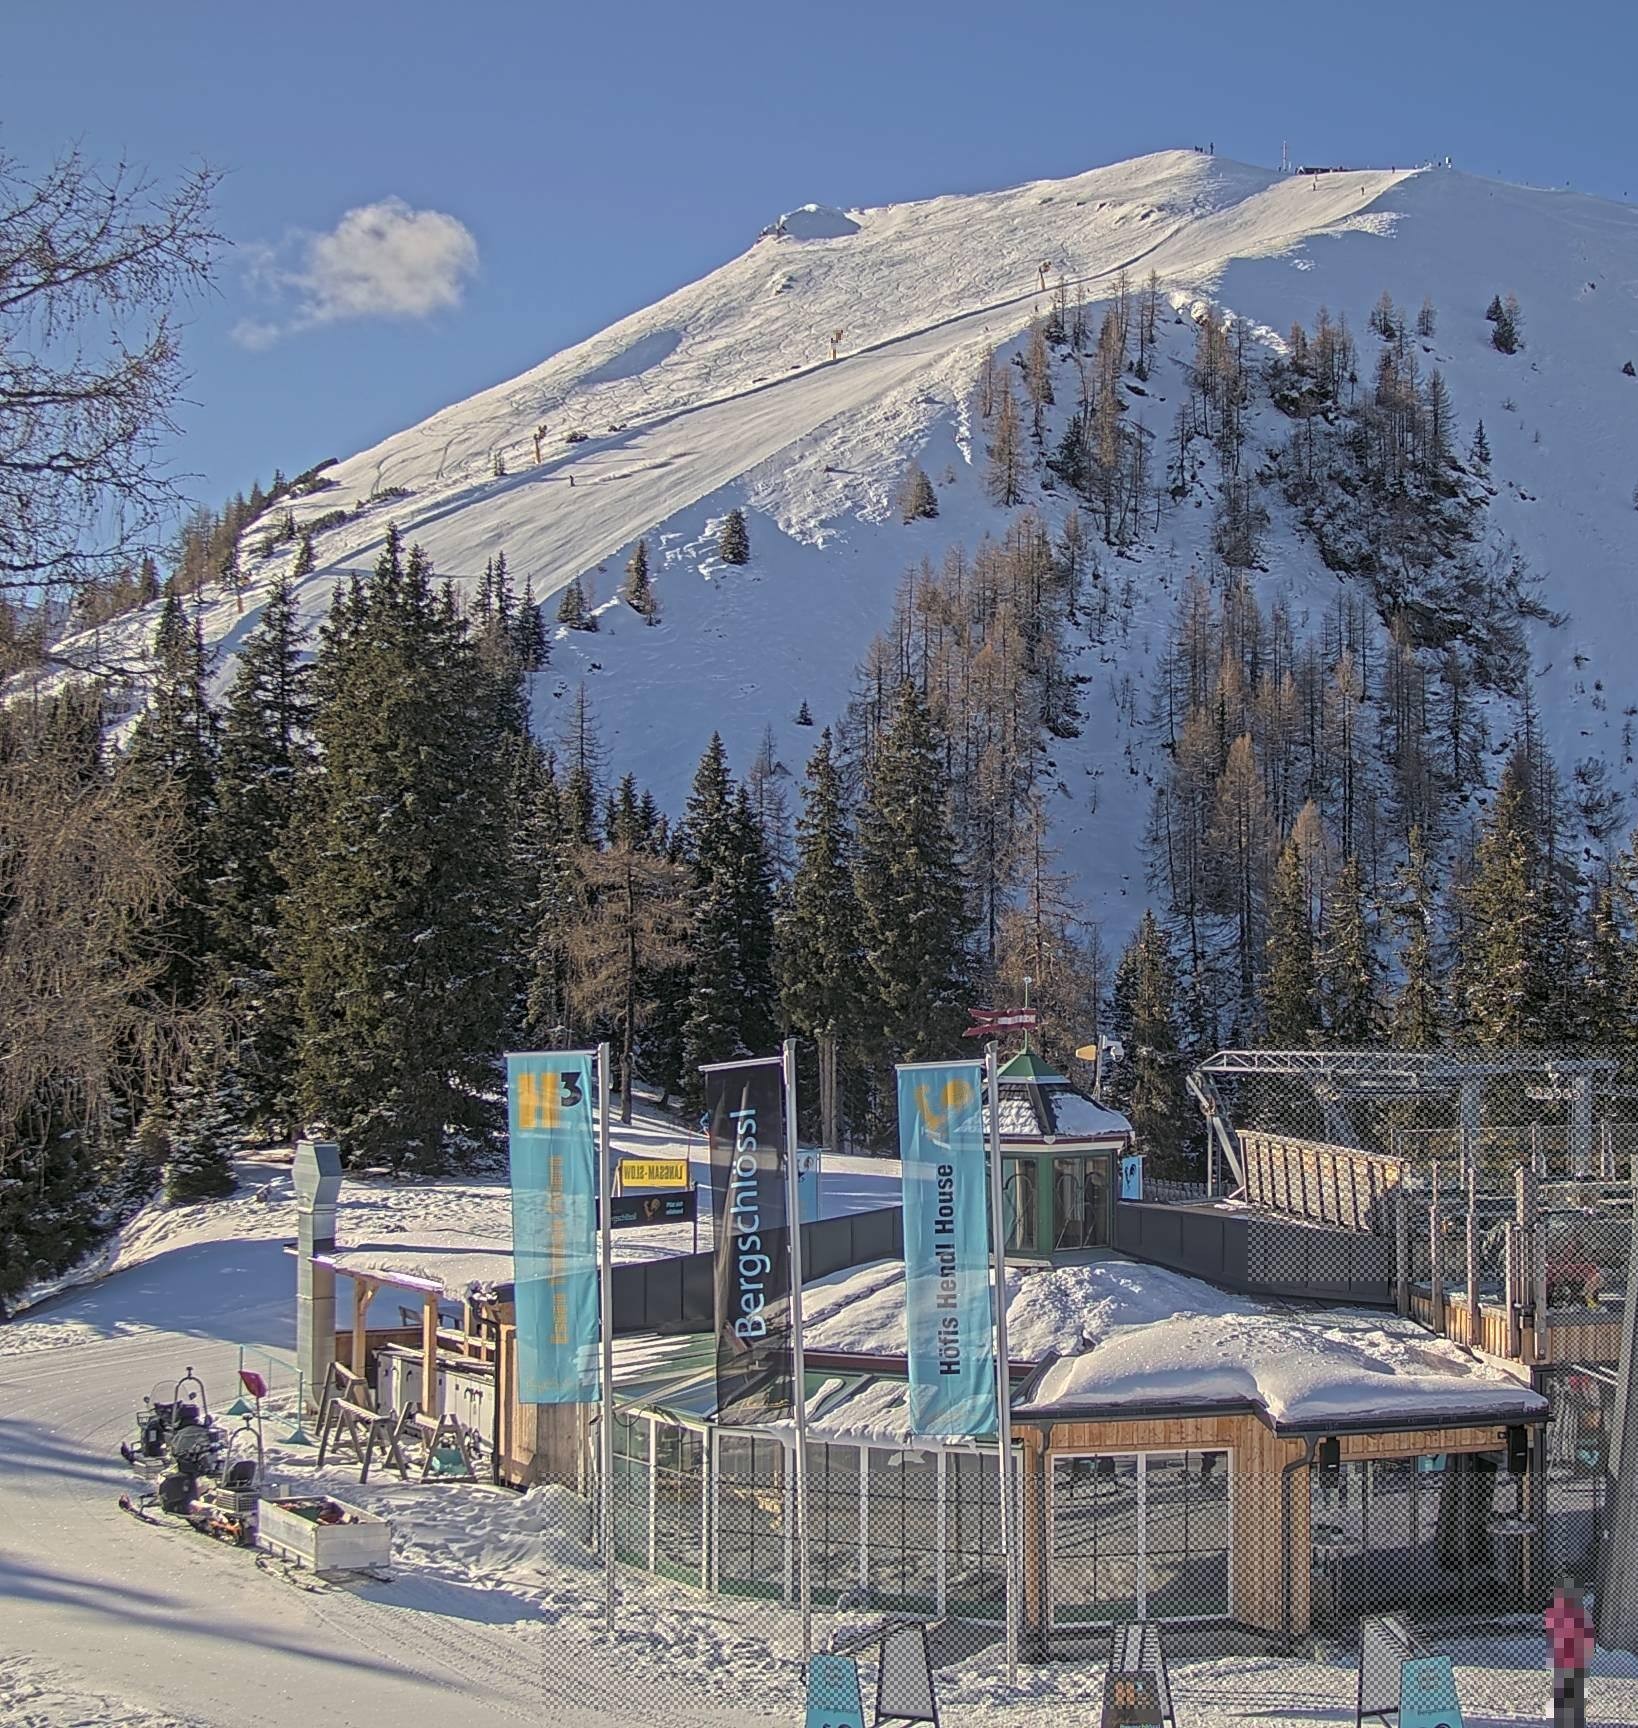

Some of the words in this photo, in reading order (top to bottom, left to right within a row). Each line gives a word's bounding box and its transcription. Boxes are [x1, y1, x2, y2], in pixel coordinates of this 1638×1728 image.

[729, 1109, 771, 1338] Bergschlössl
[934, 1164, 954, 1234] House
[935, 1243, 958, 1309] Hendl
[938, 1316, 961, 1376] Höfis
